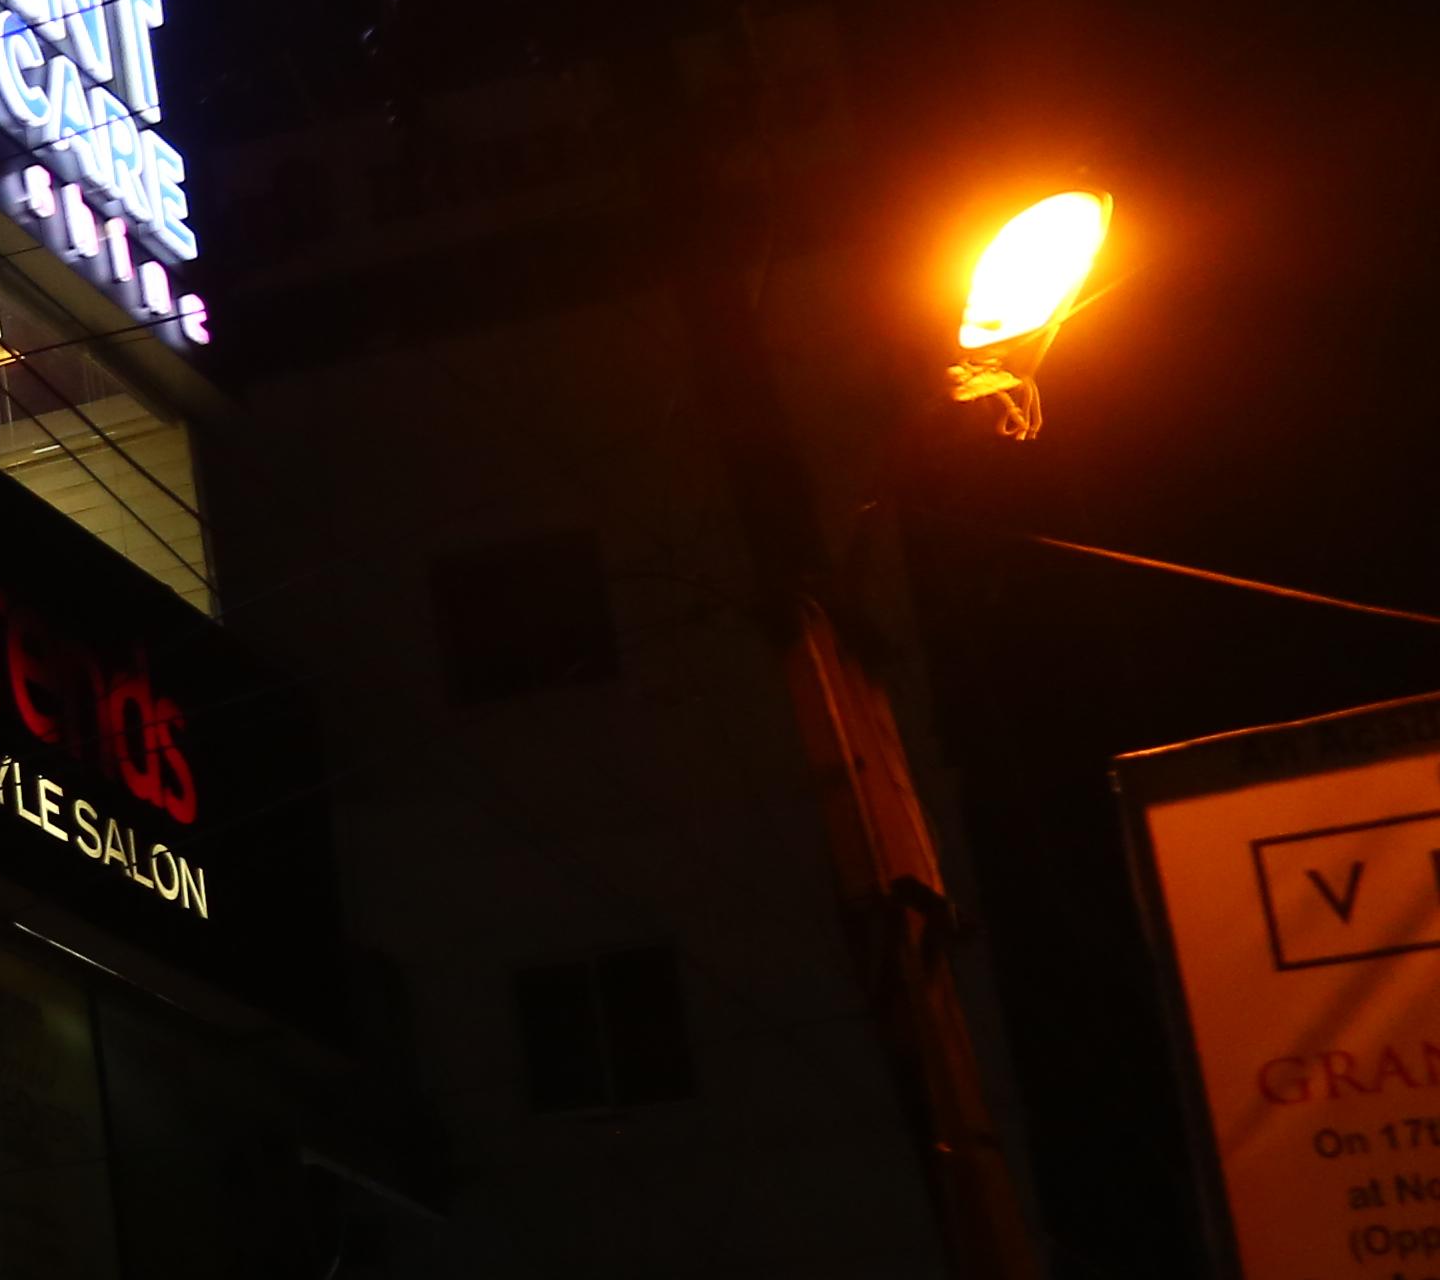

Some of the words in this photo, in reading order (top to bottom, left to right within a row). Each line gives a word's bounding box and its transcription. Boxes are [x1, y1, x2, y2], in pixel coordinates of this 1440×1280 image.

[24, 163, 211, 346] shine
[74, 798, 209, 920] SALON
[1312, 1123, 1370, 1160] On
